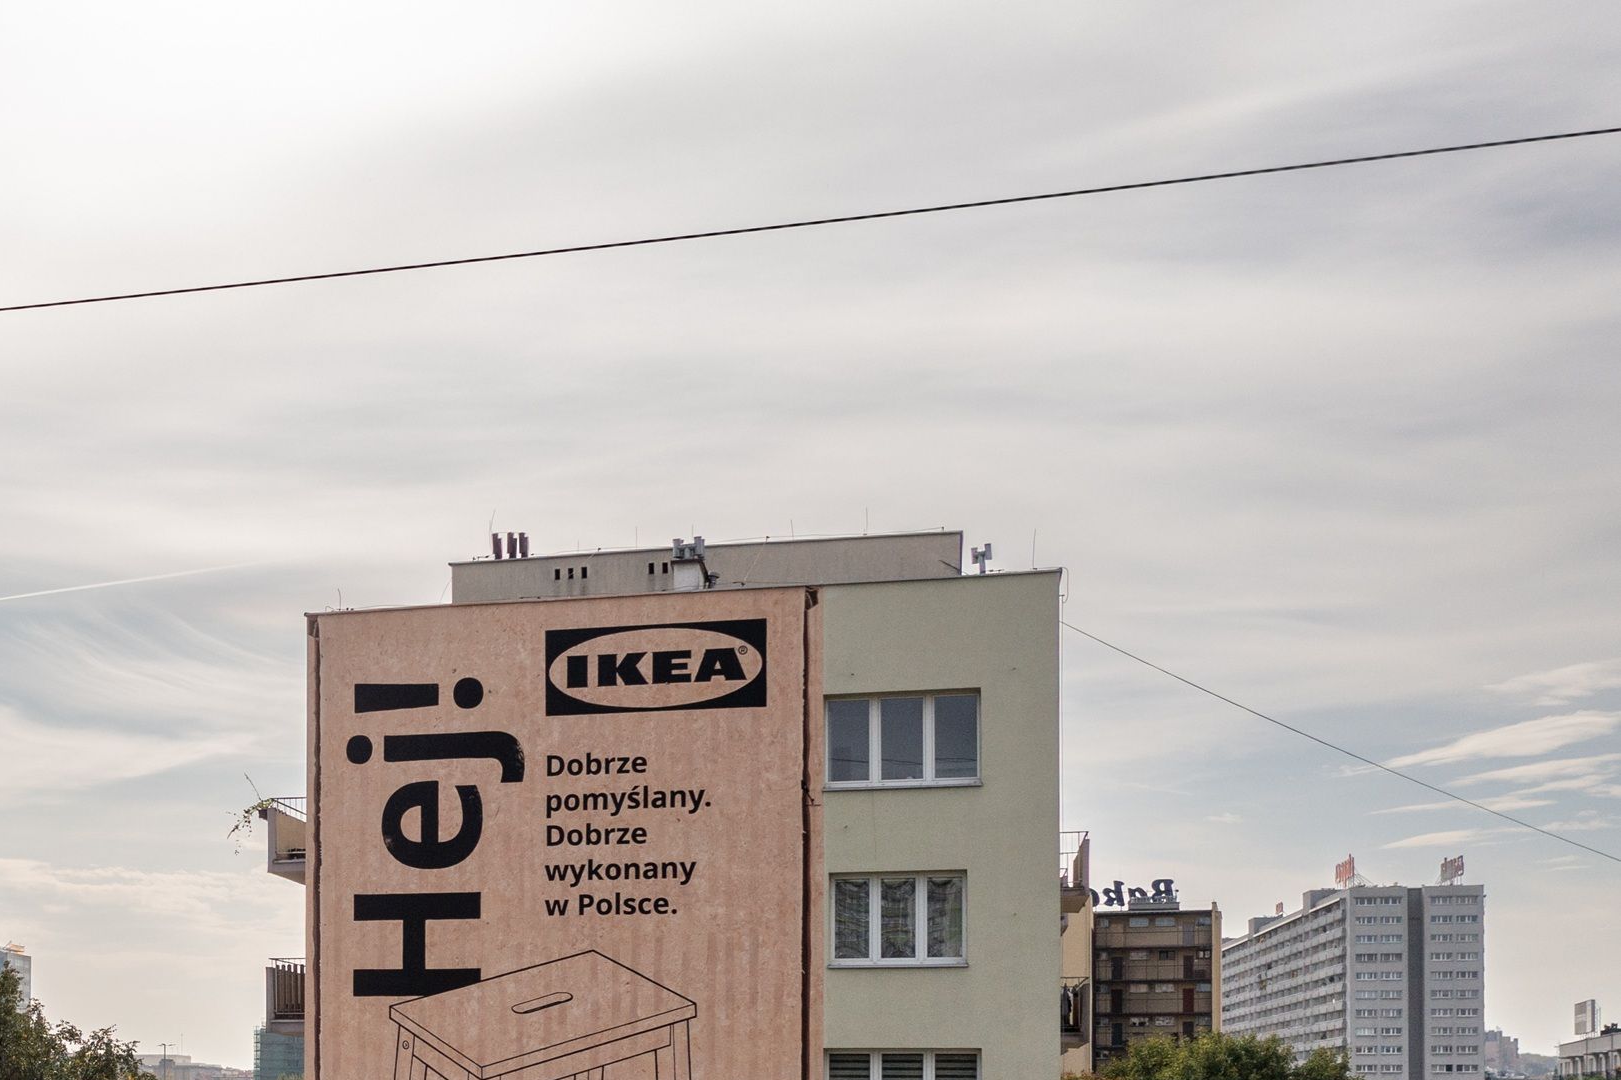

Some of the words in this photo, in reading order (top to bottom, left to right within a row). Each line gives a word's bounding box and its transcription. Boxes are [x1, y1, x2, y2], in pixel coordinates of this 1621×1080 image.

[546, 752, 648, 777] Dobrze
[546, 785, 711, 818] pomyślany.
[346, 677, 525, 997] Hej!
[546, 823, 648, 847] Dobrze
[545, 859, 697, 888] wykonany
[545, 899, 569, 916] w
[579, 892, 677, 915] Polsce.
